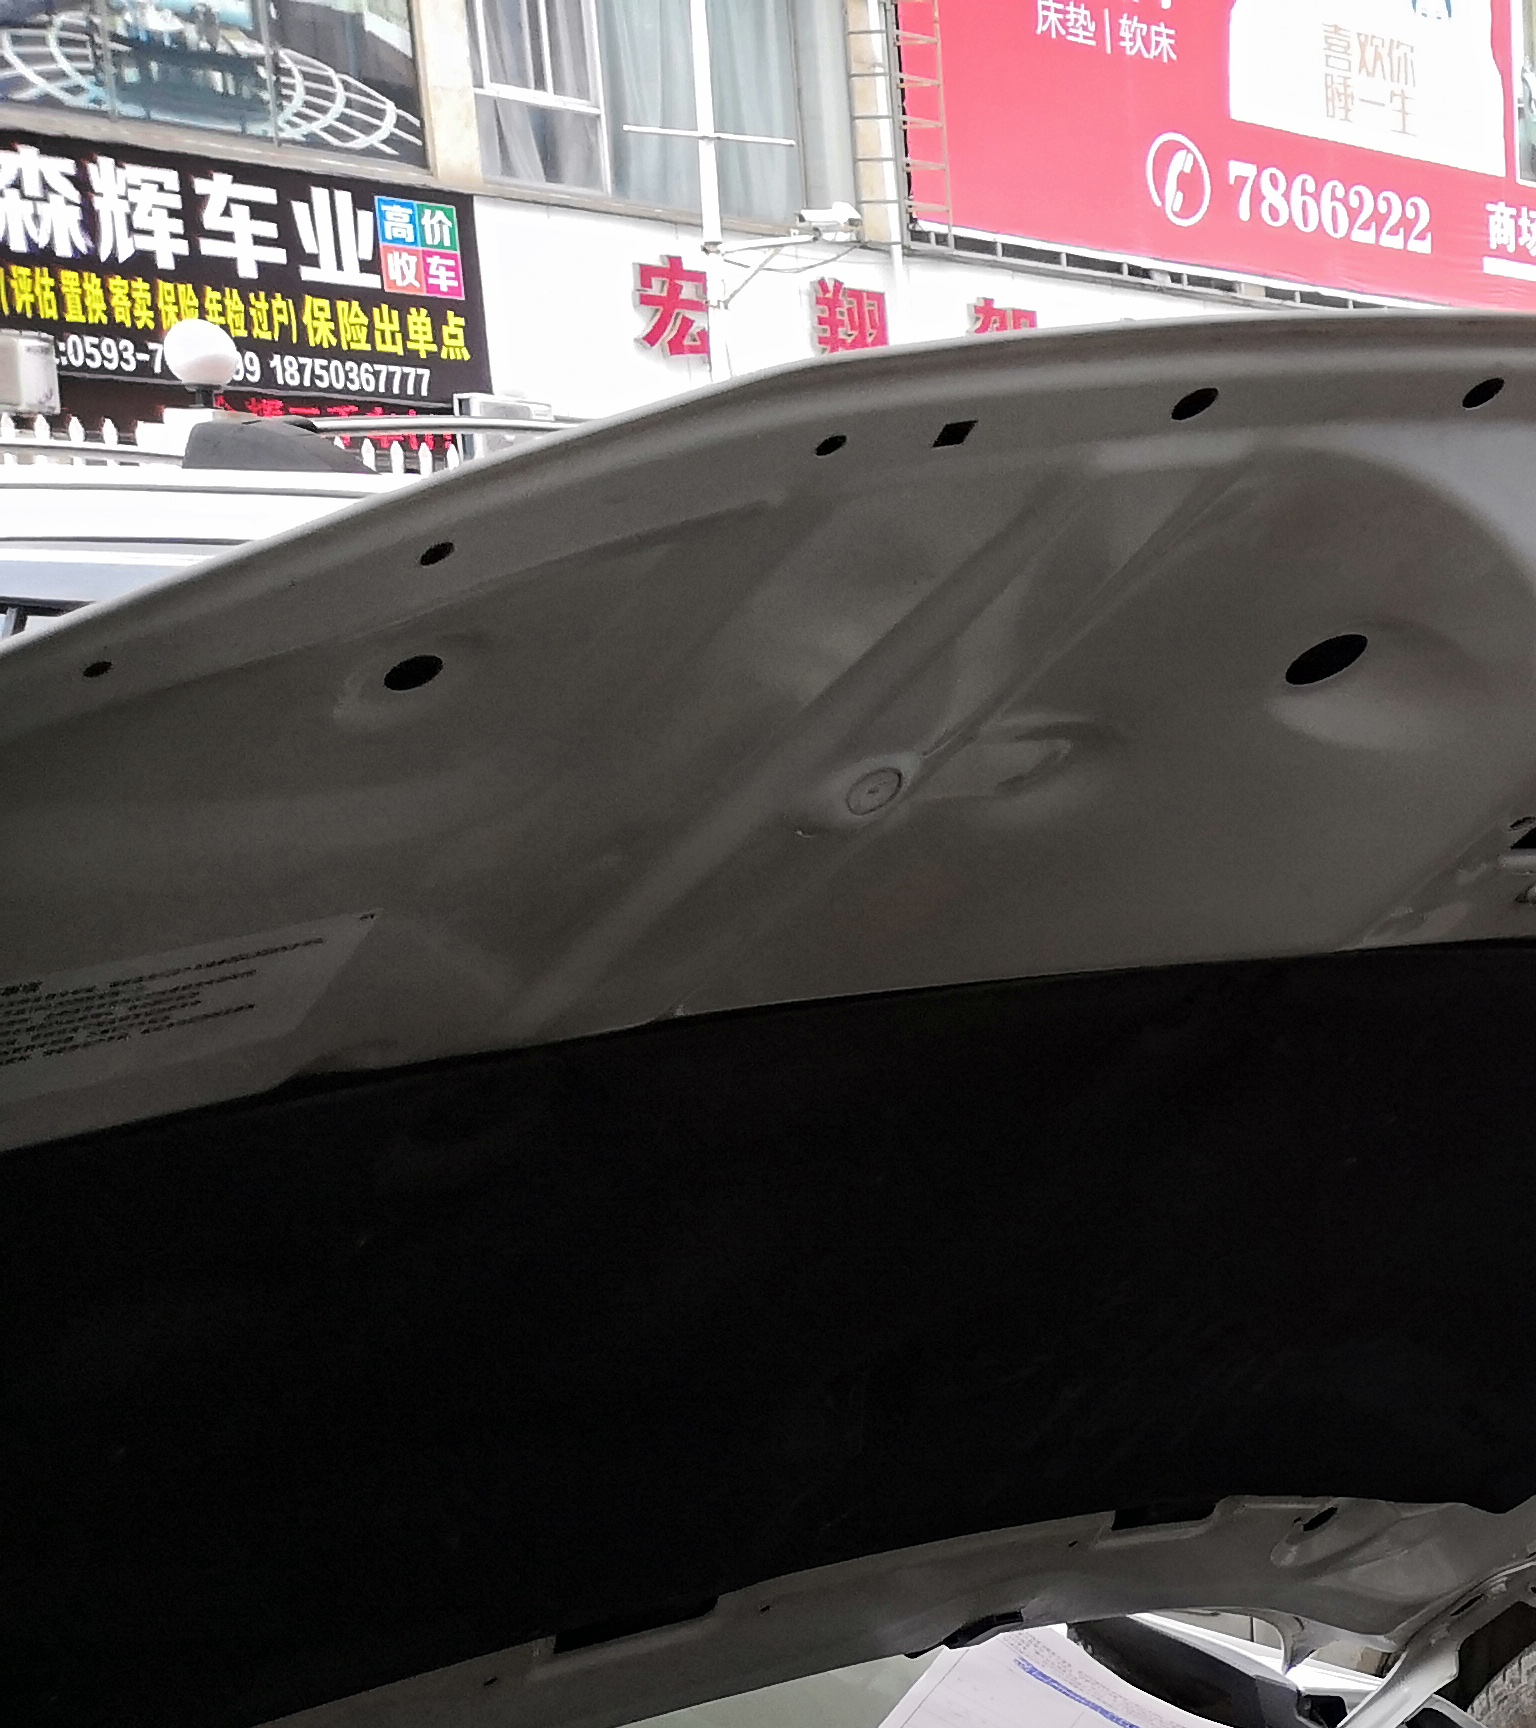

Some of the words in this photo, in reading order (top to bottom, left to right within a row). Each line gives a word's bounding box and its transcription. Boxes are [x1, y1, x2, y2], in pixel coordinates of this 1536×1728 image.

[1322, 23, 1417, 87] 喜欢你
[1324, 73, 1418, 137] 睡一生
[0, 143, 382, 290] 森辉车业
[380, 202, 454, 249] 高价
[1228, 159, 1432, 255] 7866222
[385, 250, 460, 293] 收车
[301, 294, 472, 362] 保险出单点
[269, 353, 431, 397] 18750367777
